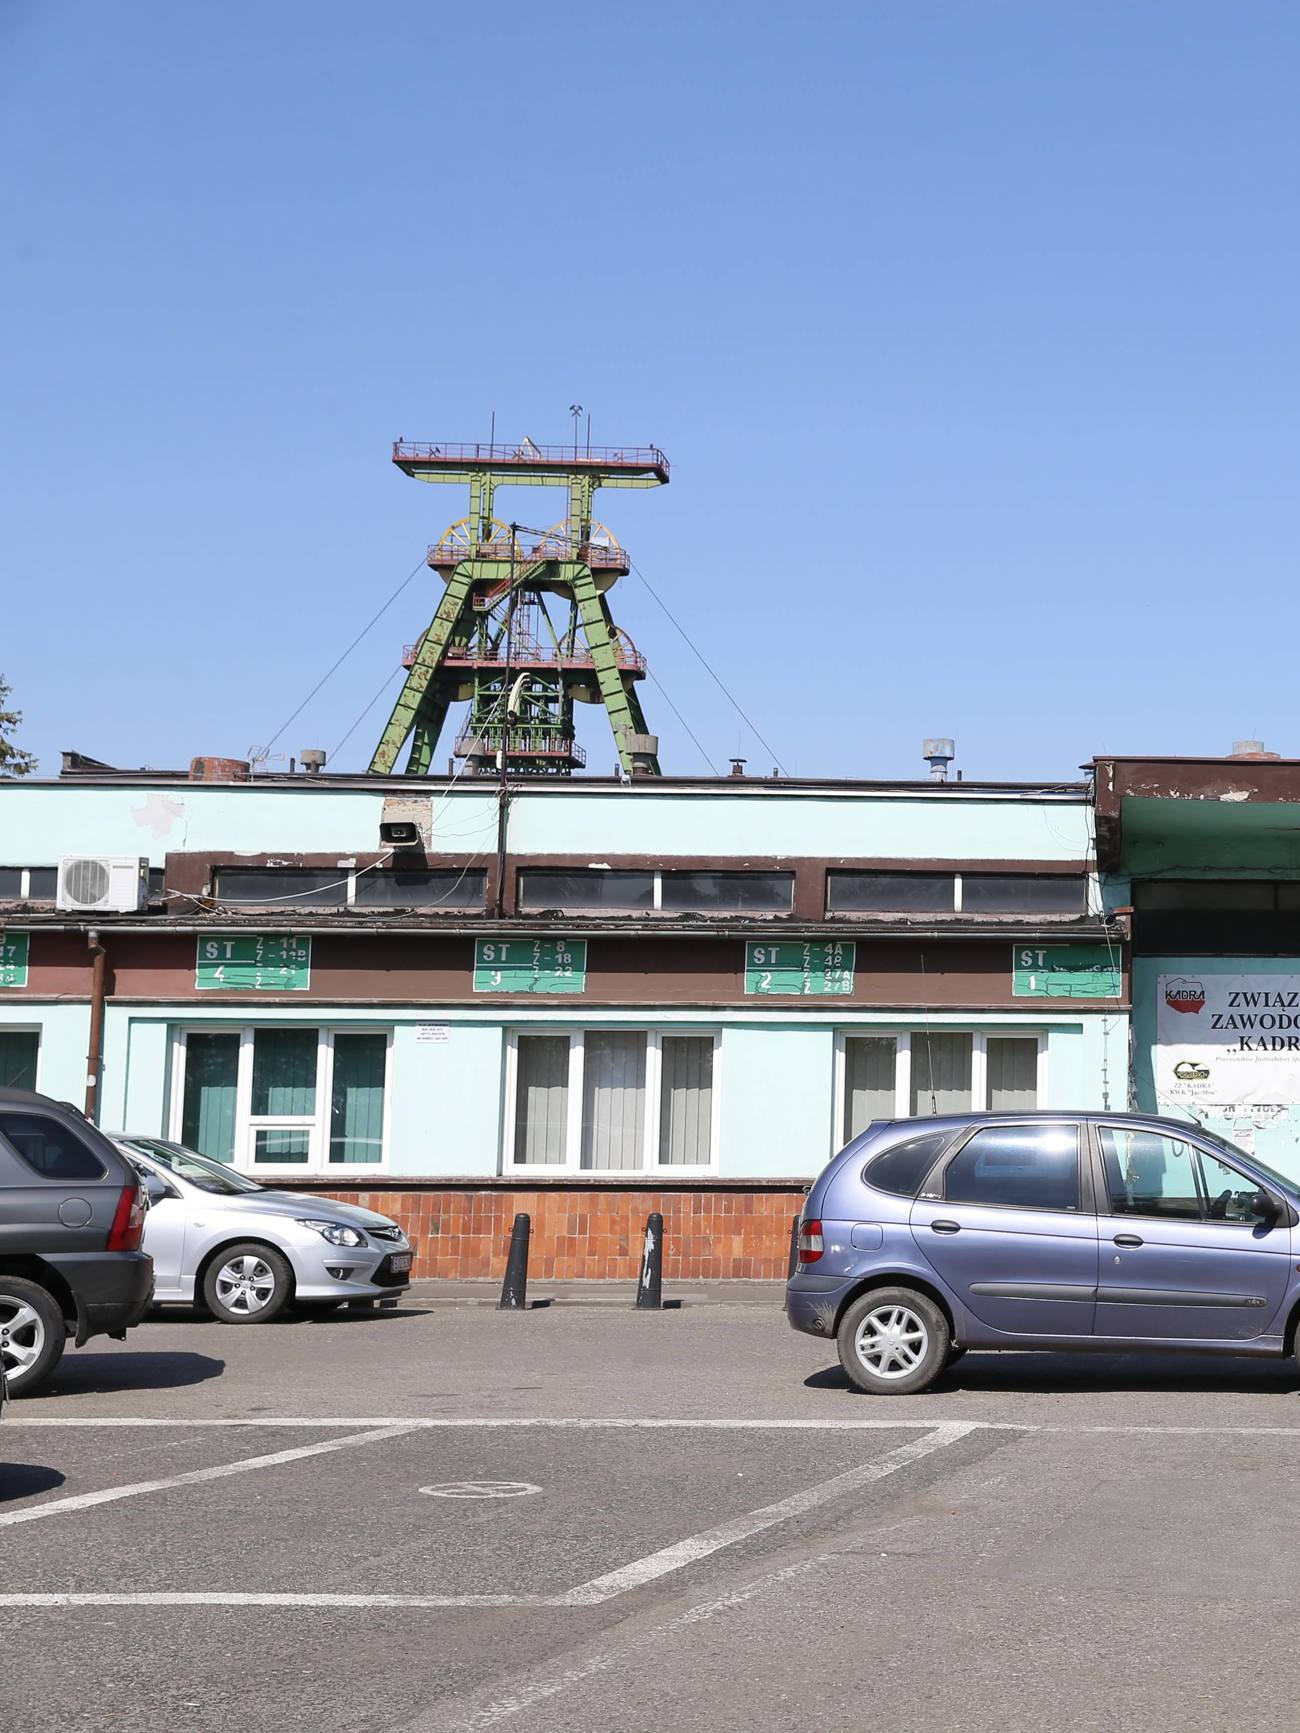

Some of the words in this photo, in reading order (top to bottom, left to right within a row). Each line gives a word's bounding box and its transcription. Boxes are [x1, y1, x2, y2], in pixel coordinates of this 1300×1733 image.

[206, 941, 236, 959] ST
[482, 943, 511, 961] ST
[753, 947, 780, 964] ST
[1021, 950, 1047, 967] ST
[761, 972, 772, 988] 2
[1029, 975, 1037, 990] 1
[1165, 990, 1206, 1000] KADRA
